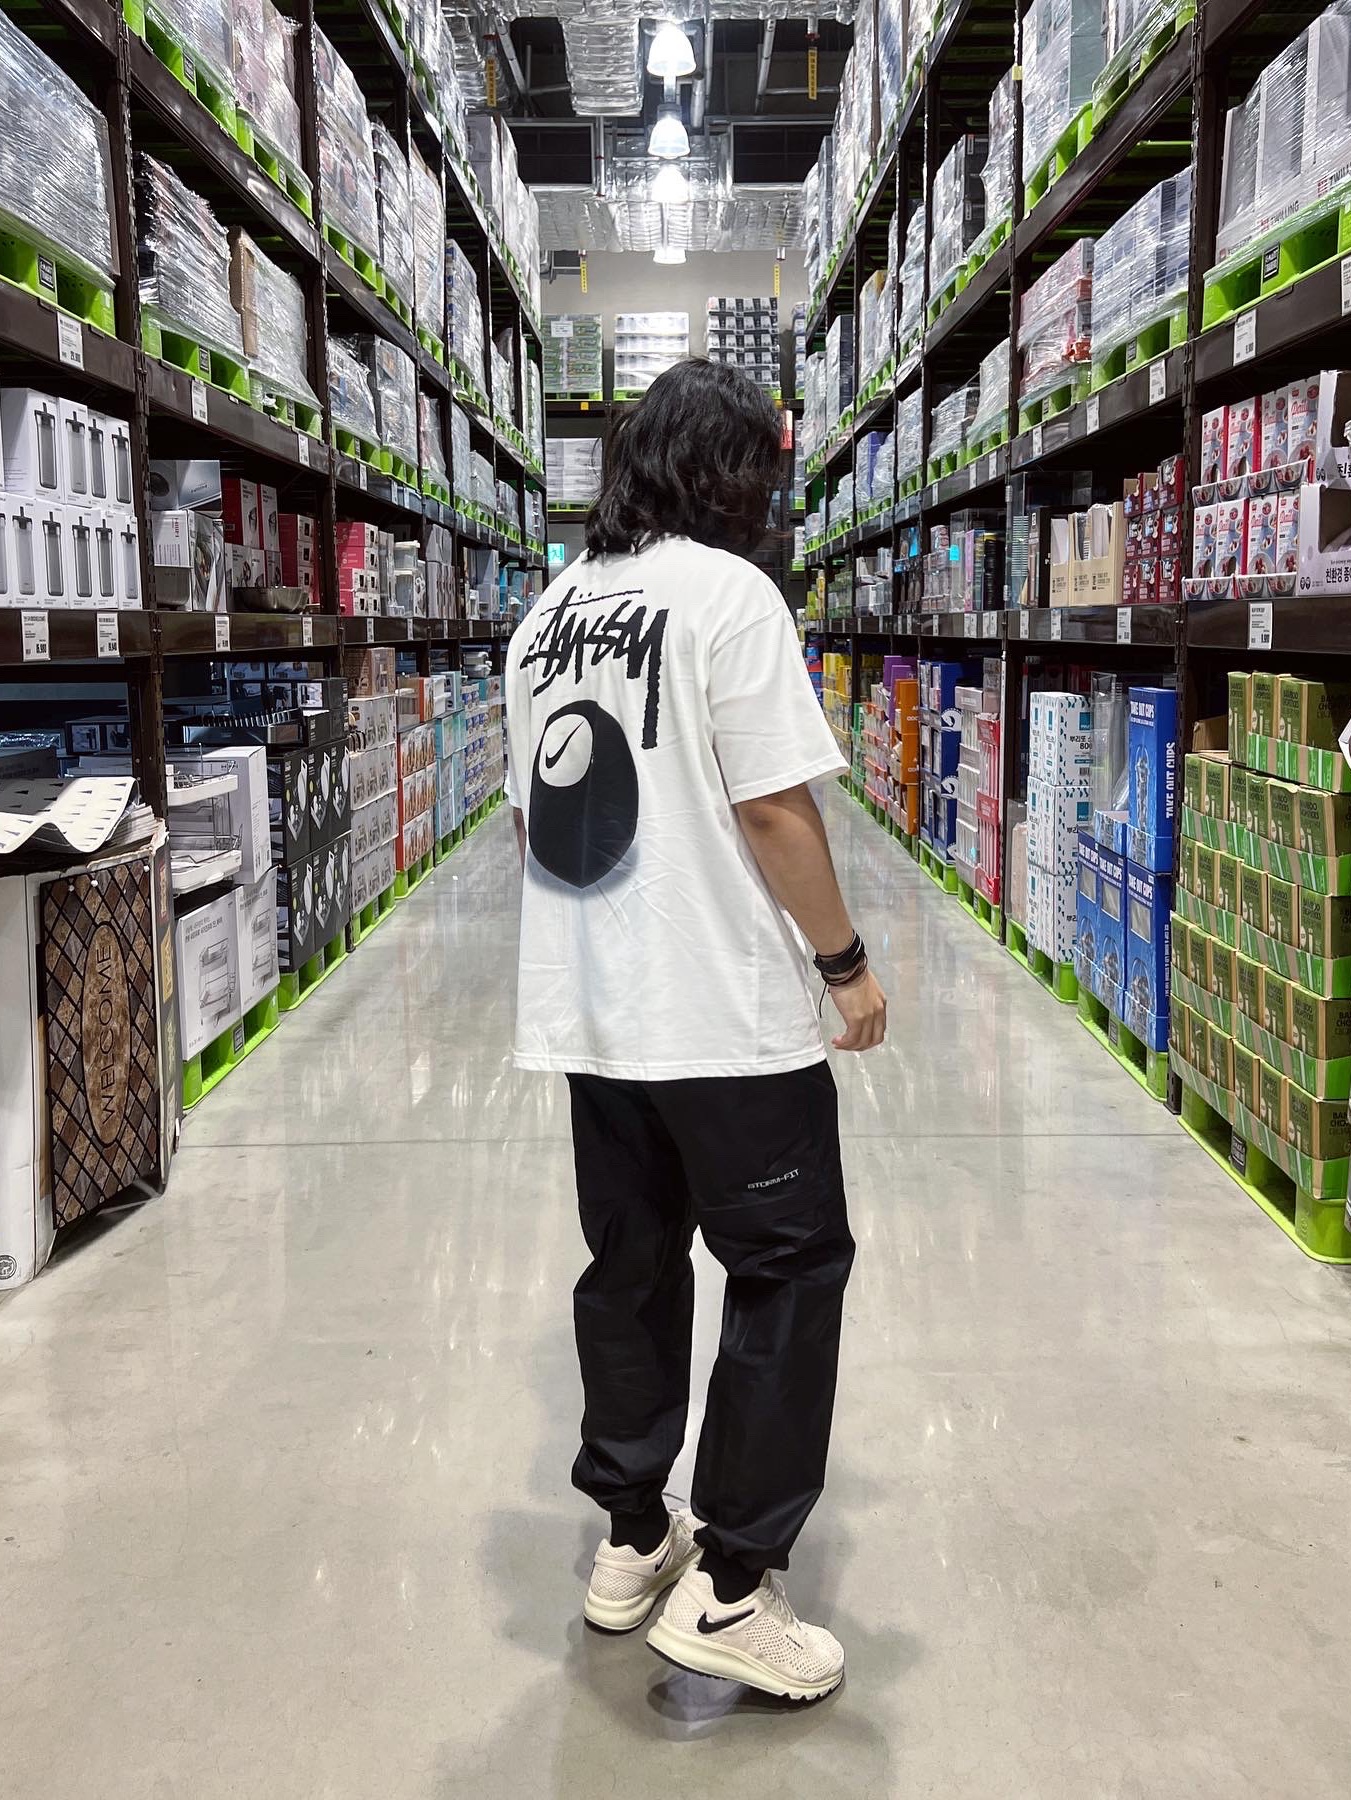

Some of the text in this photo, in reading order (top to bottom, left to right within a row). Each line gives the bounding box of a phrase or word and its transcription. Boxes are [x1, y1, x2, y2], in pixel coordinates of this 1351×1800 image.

[1165, 742, 1176, 819] TAKE OUT CUPS
[95, 945, 115, 1125] WELCOME
[747, 1168, 799, 1189] STORM-FIT
